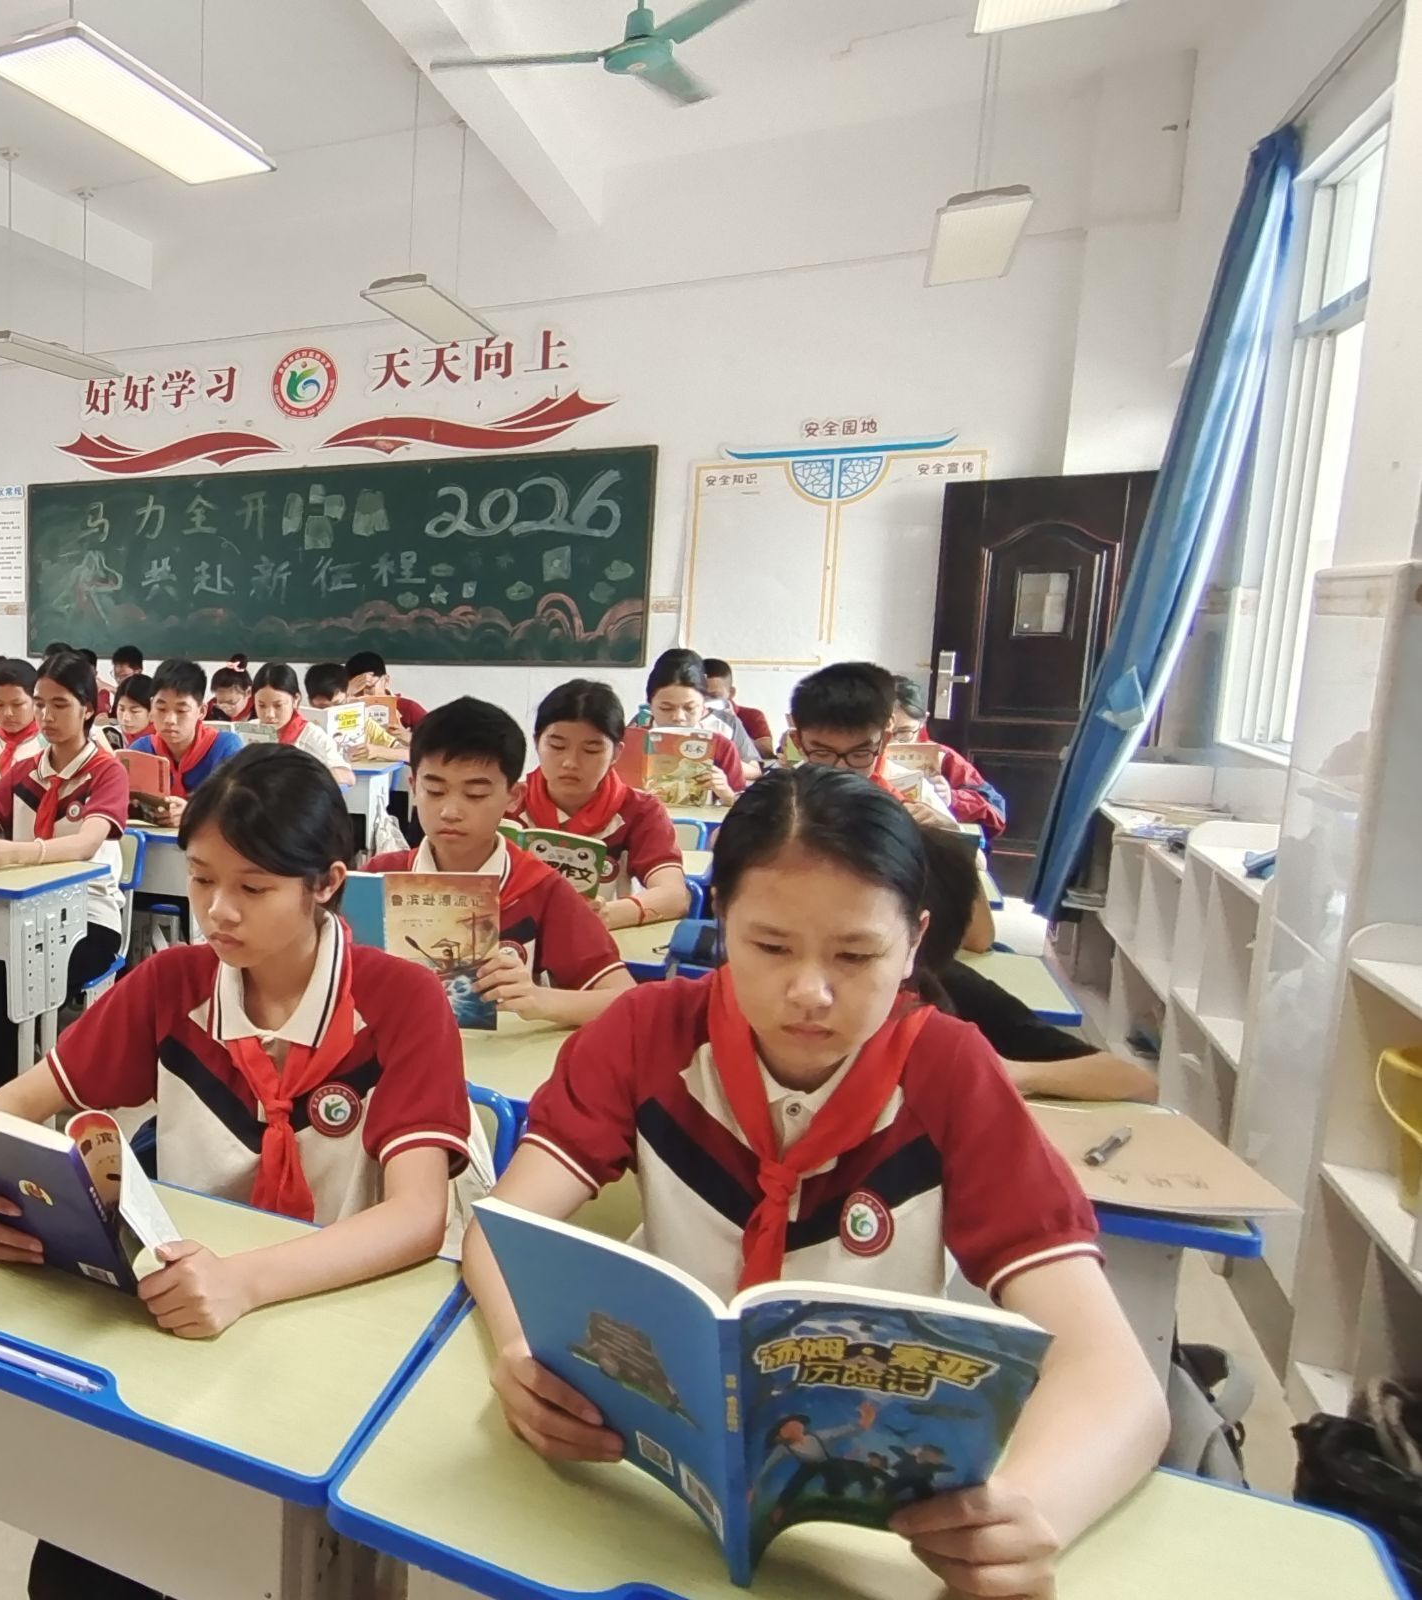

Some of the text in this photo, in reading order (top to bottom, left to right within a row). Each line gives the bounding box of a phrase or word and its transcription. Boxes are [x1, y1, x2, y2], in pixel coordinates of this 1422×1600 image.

[372, 330, 569, 393] 天天向上
[85, 366, 238, 416] 好好学习
[804, 418, 878, 437] 安全园地
[705, 473, 758, 486] 安全知识
[917, 462, 975, 475] 安全宣传
[78, 491, 266, 543] 马力全开
[425, 469, 622, 539] 2026
[141, 549, 426, 601] 共赴新征程
[801, 1362, 928, 1395] 历险记
